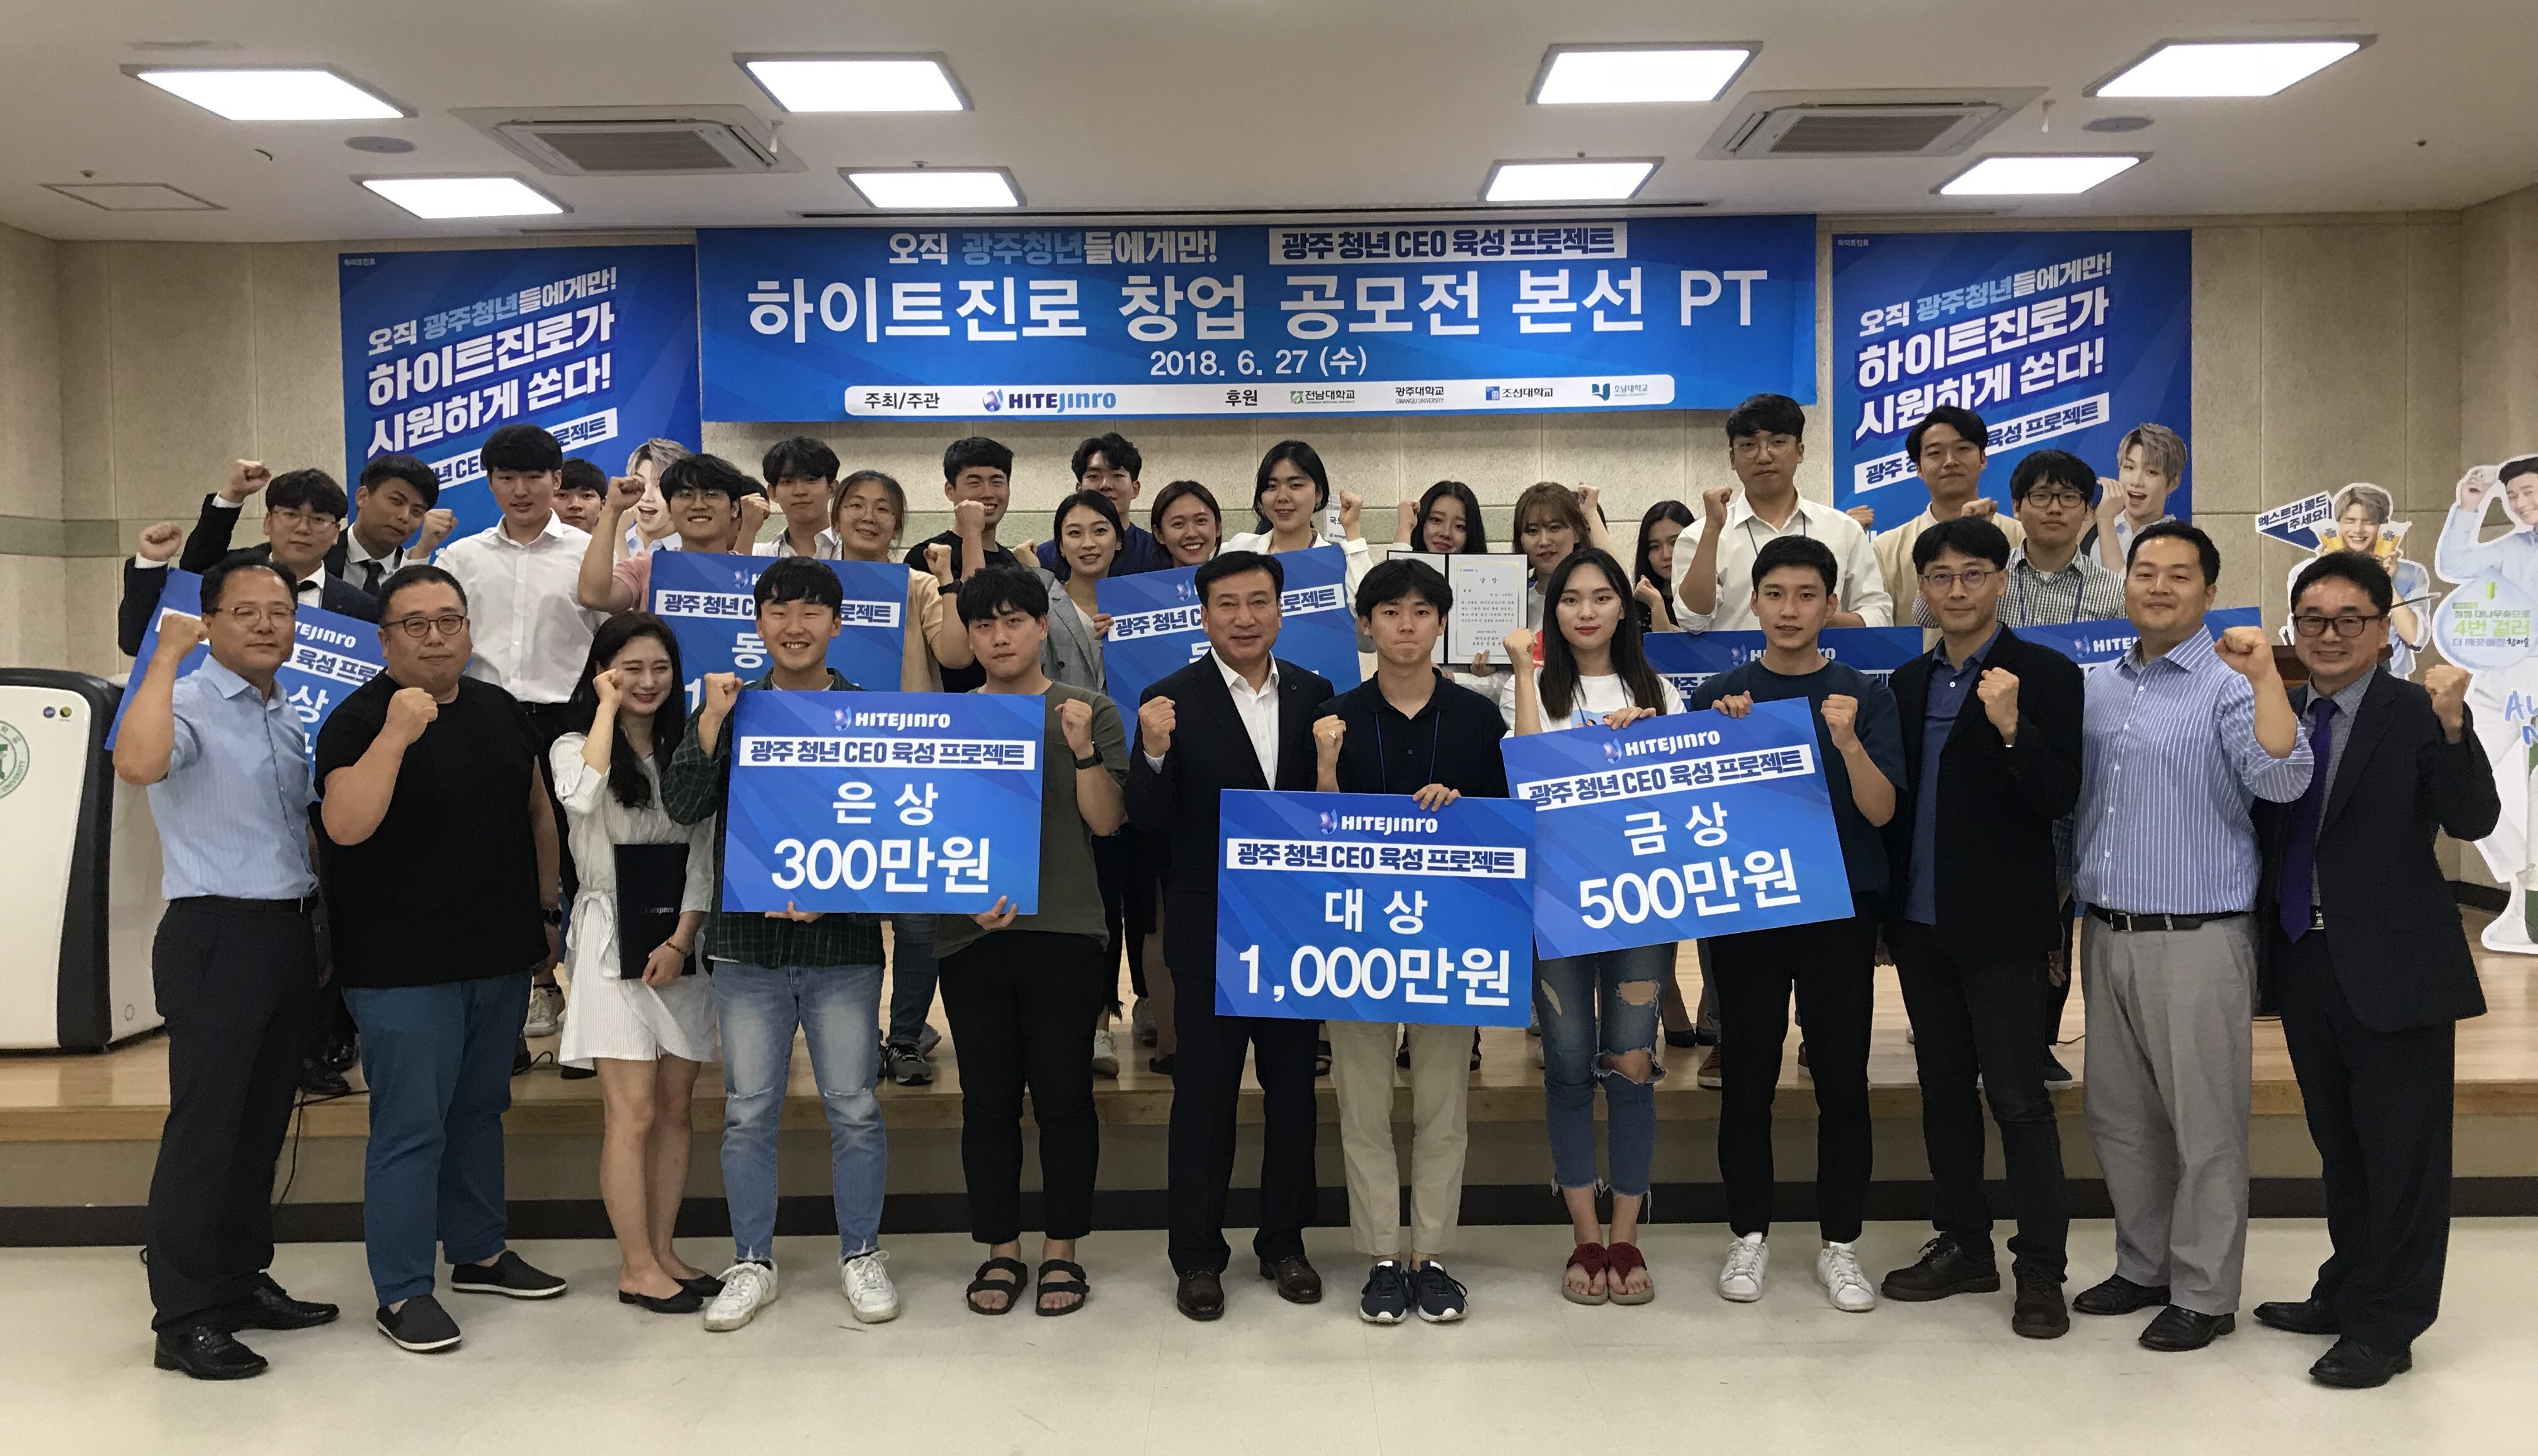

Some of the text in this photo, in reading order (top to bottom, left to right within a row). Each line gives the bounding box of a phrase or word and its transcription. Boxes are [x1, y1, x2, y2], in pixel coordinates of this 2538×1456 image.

[888, 230, 1218, 264] 오직 광주청년들에게만!
[1281, 227, 1615, 260] 광주 청년 CEO 육성 프로젝트
[748, 266, 1768, 344] 하이트진로 창업 공모전 본선 PT
[1859, 252, 2112, 337] 오직 광주청년들에게만!
[368, 266, 616, 356] 오직 광주청년들에게만!
[1859, 286, 2109, 387] 하이트진로가
[368, 302, 615, 406] 하이트진로가
[1150, 346, 1368, 378] 2018. 6. 27 (수)
[864, 390, 940, 411] 주최/주관
[1225, 388, 1258, 407] 후원
[1305, 390, 1355, 400] 전남대학교
[1395, 386, 1444, 397] 광주대학교
[1502, 387, 1553, 398] 조선대학교
[1614, 384, 1648, 393] 호남대학교
[1855, 337, 2104, 441] 시원하게 쏜다!
[367, 353, 611, 460] 시원하게 쏜다!
[2025, 401, 2099, 439] 프로젝트
[552, 416, 607, 447] 로젝트
[1866, 456, 1902, 484] 광주
[2259, 494, 2327, 526] 엑스트라 콜드
[2289, 507, 2327, 529] 주세요!
[664, 594, 700, 613] 광주
[704, 595, 740, 615] 청년
[841, 603, 891, 623] 로젝트
[1115, 617, 1150, 637] 광주
[1153, 612, 1187, 631] 청년
[2454, 620, 2530, 636] 4번 걸러
[297, 648, 336, 675] 육성
[732, 633, 768, 669] 동
[288, 685, 329, 723] 상
[750, 740, 1025, 766] 광주 청년 CEO 육성 프로젝트
[1528, 750, 1804, 807] 광주 청년 CEO 육성 프로젝트
[772, 837, 989, 893] 300만원
[1238, 843, 1515, 874] 광주 청년 CEO 육성 프로젝트
[1580, 848, 1801, 930] 500만원
[1240, 945, 1509, 1007] 1,000만원
